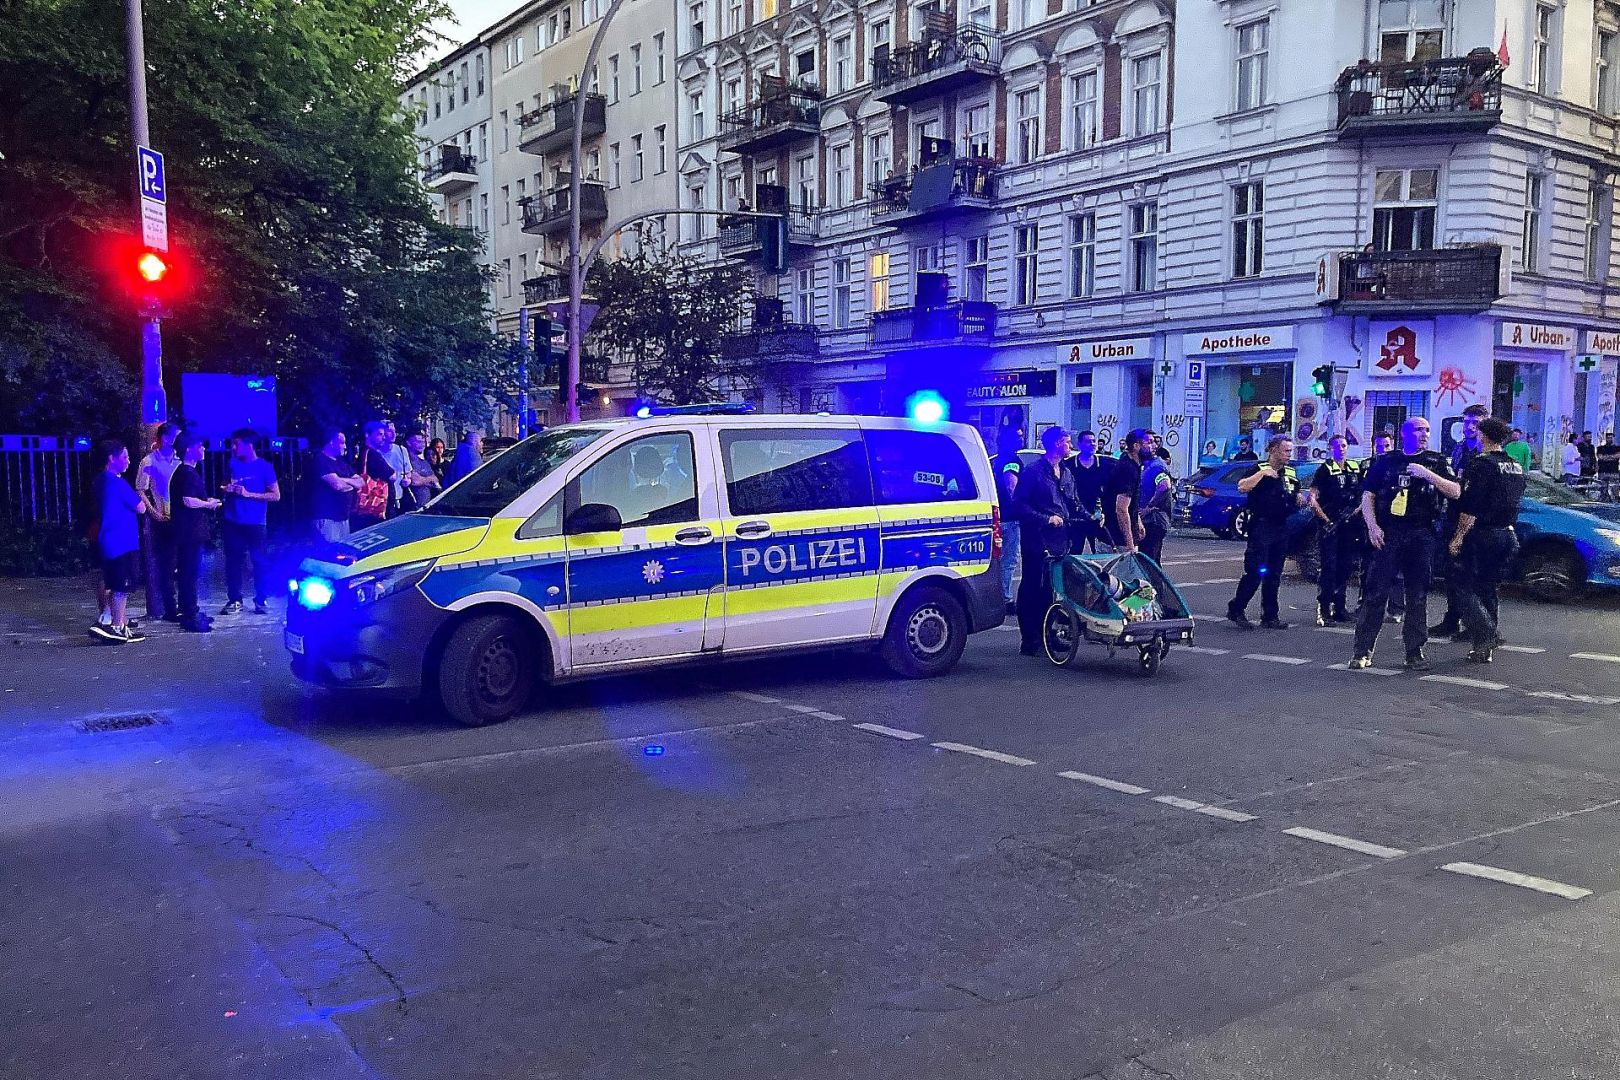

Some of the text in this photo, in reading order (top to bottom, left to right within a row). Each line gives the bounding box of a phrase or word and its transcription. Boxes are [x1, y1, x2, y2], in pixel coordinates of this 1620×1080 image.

[142, 153, 157, 191] P
[1200, 334, 1271, 351] Apotheke
[1092, 344, 1134, 358] Urban
[1191, 365, 1199, 378] P
[967, 541, 984, 552] 110
[741, 537, 866, 576] POLIZEI
